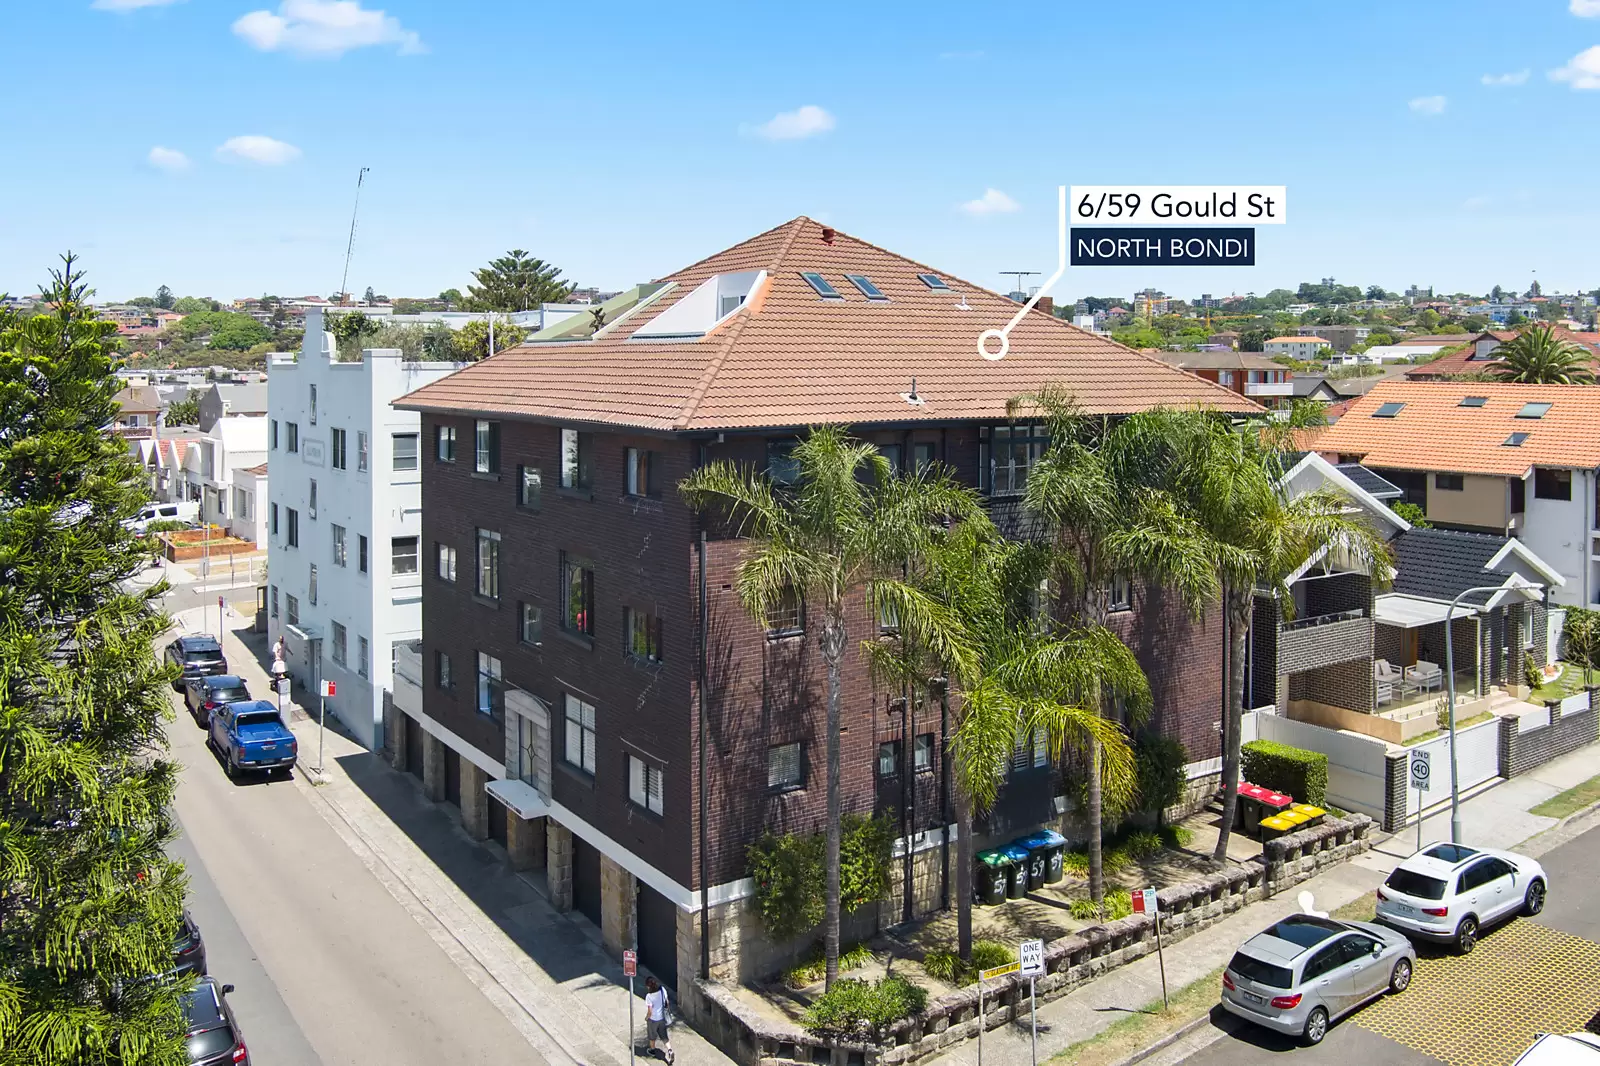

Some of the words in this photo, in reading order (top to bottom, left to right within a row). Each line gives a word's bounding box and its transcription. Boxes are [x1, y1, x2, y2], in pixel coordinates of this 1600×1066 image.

[1412, 750, 1429, 759] END
[1413, 764, 1428, 775] 40
[1411, 780, 1429, 789] AREA
[1031, 860, 1045, 876] 59
[1023, 943, 1040, 952] ONE
[1023, 953, 1041, 963] WAY
